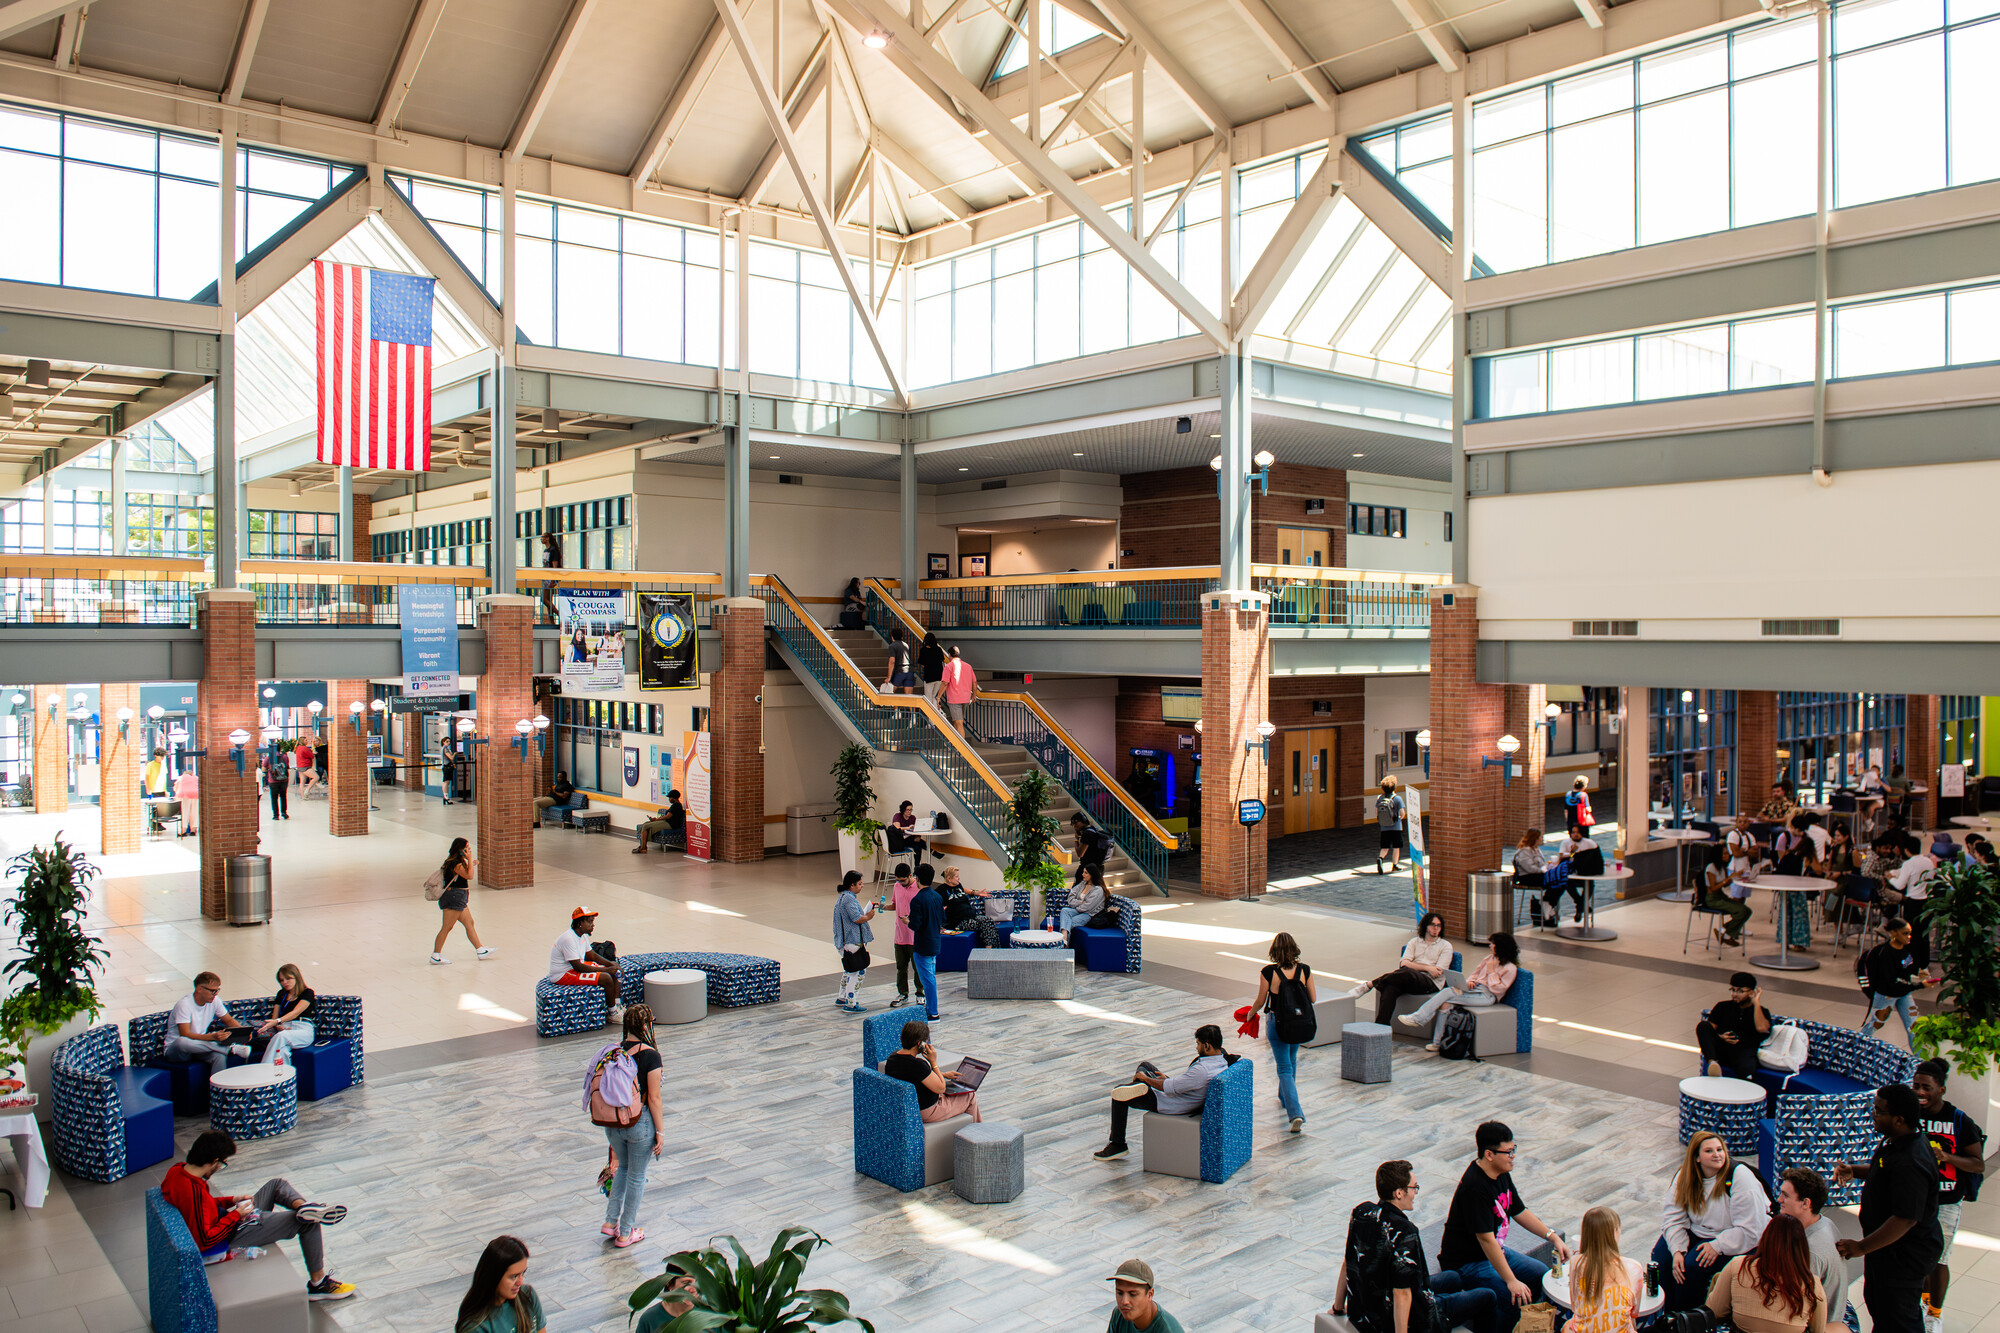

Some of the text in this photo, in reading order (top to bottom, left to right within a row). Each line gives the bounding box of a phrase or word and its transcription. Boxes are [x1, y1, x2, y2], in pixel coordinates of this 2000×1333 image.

[413, 627, 446, 635] Purposeful
[421, 674, 451, 682] CONNECTED
[1927, 1120, 1955, 1135] LOV
[1939, 1181, 1957, 1191] LEY
